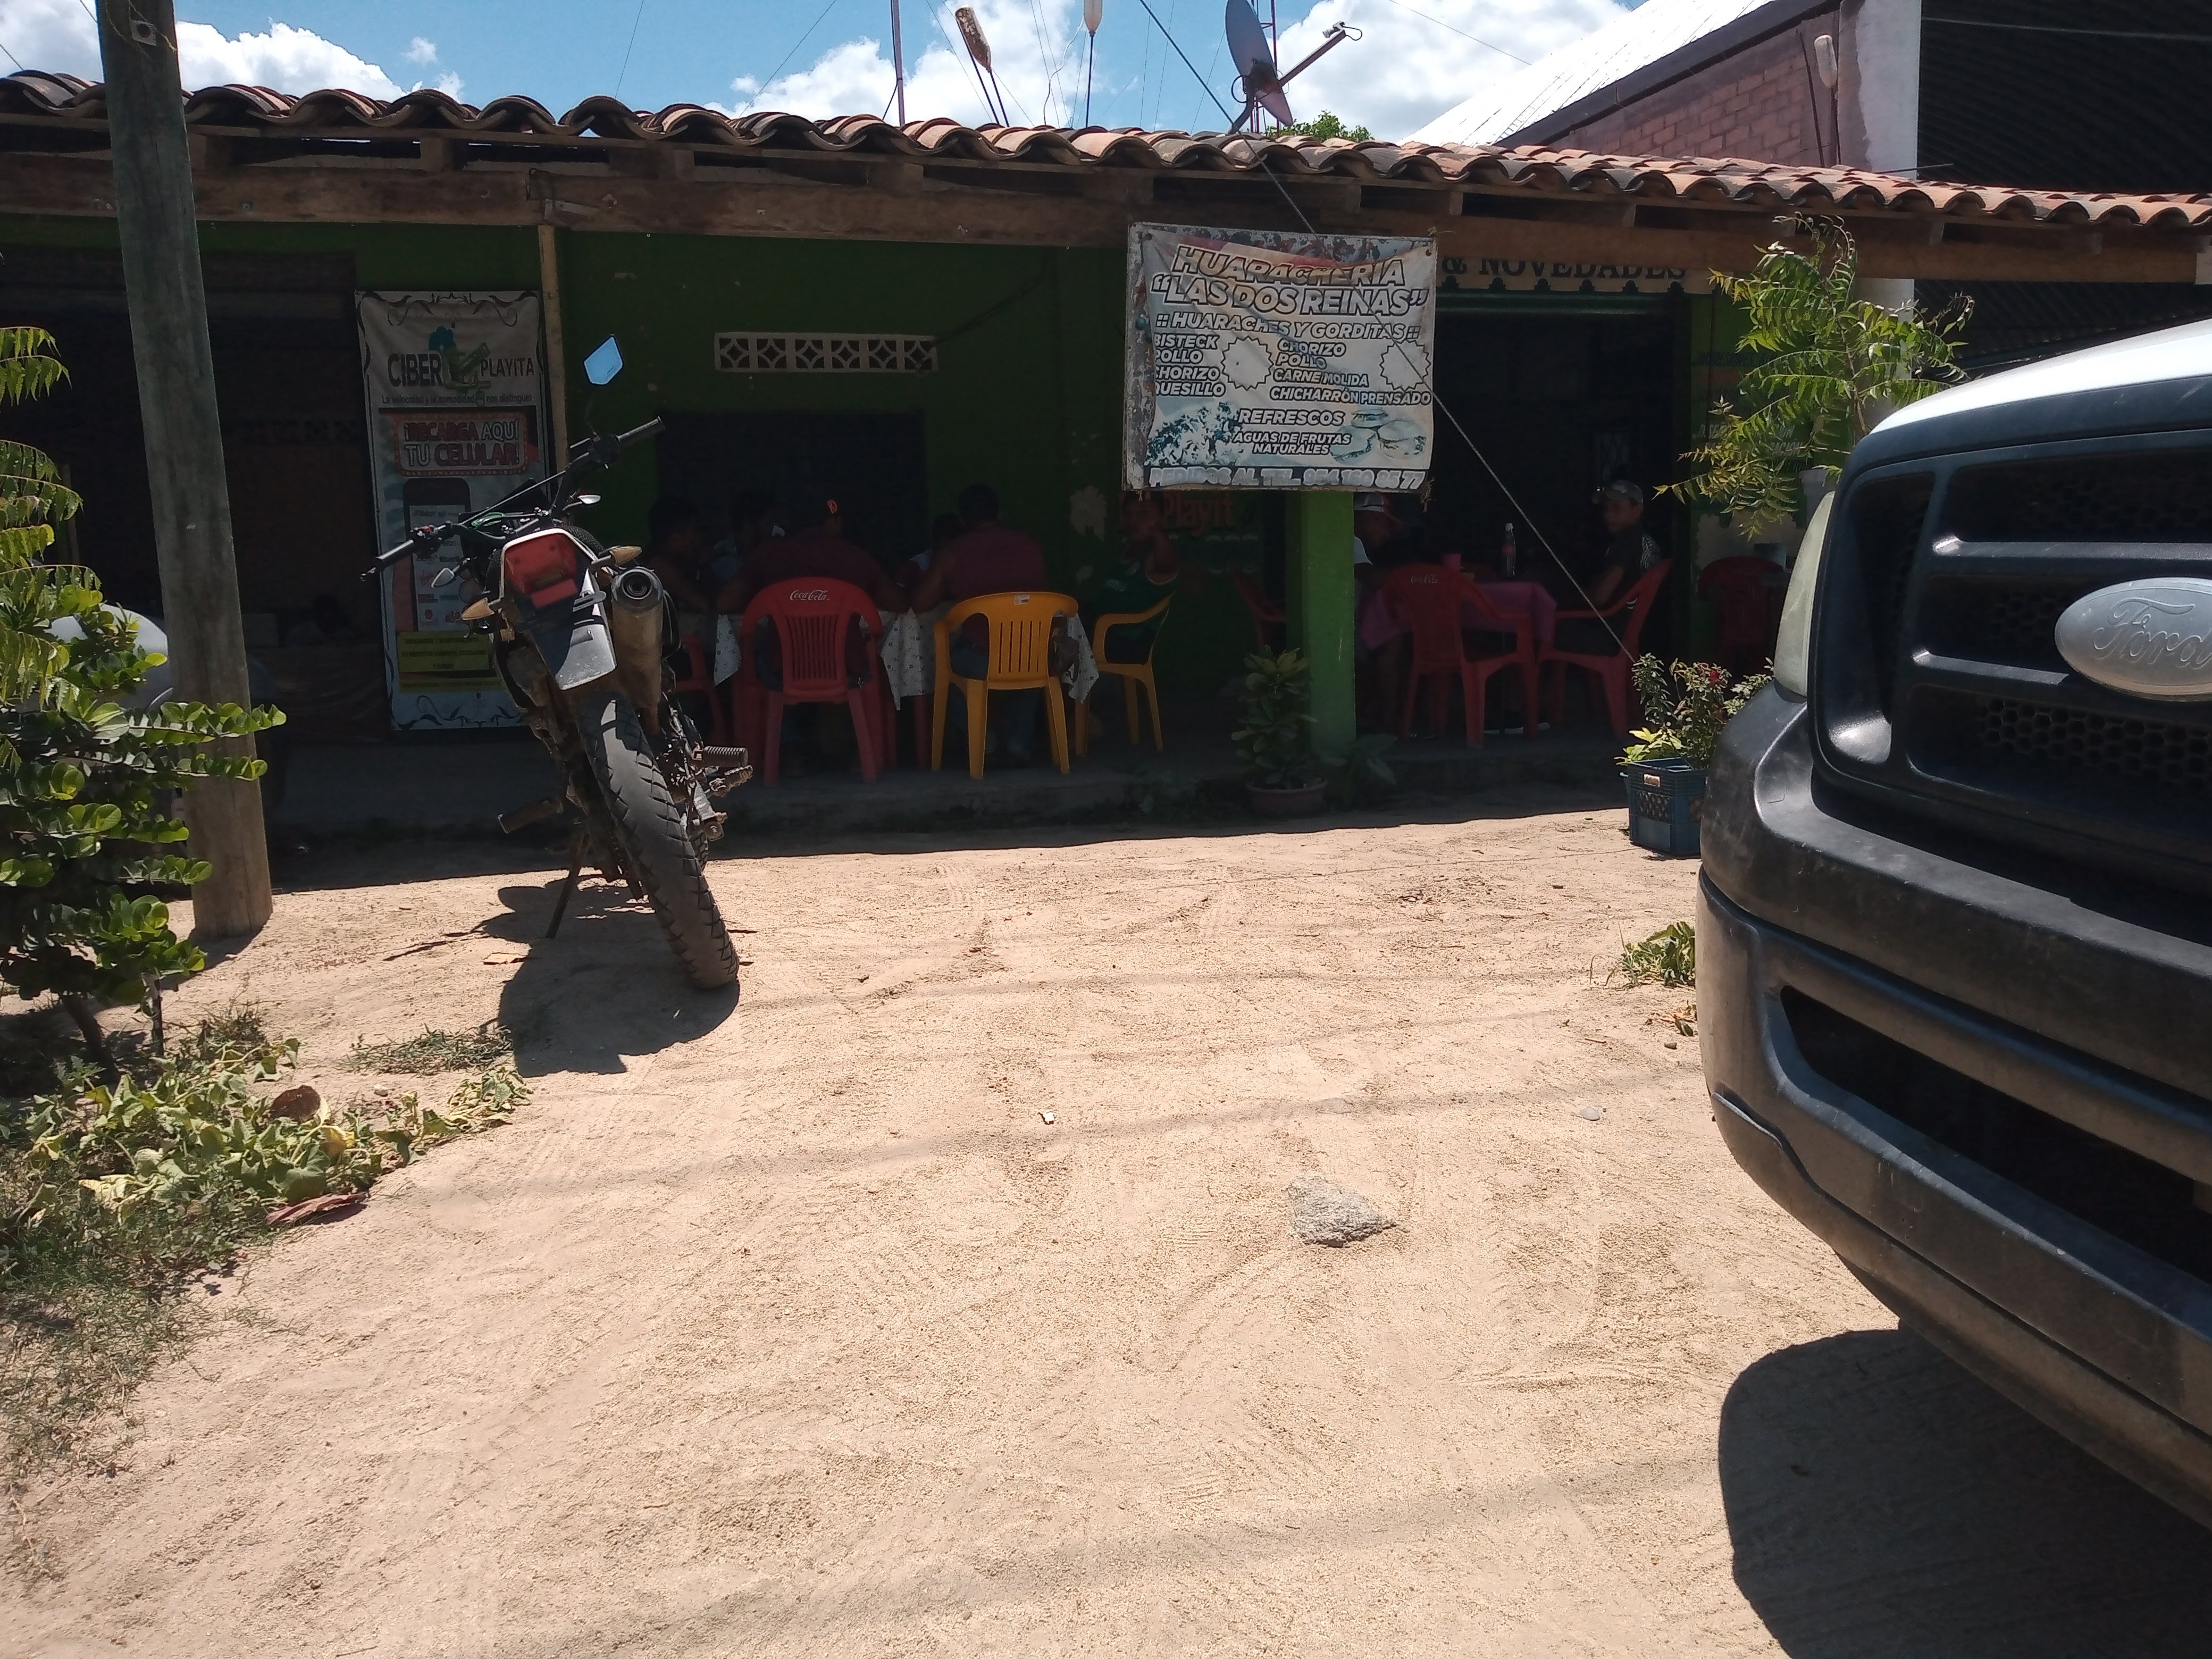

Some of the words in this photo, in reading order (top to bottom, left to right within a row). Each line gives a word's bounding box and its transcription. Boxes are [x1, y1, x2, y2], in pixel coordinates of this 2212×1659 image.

[1479, 258, 1686, 280] NOVEDADES
[1231, 284, 1299, 314] DOS
[1170, 312, 1292, 336] HUARACHES
[1294, 322, 1312, 338] Y
[1310, 322, 1406, 340] GORDITAS
[1153, 333, 1220, 349] BISTECK
[1278, 338, 1346, 357] CHORIZO
[388, 353, 444, 387] CIBER
[481, 357, 535, 377] PLAYITA
[1275, 353, 1327, 370] POLLO
[1273, 368, 1322, 384] CARNE
[1321, 372, 1369, 388] MOLIDA
[1270, 386, 1359, 404] CHICHARRÓN
[1360, 391, 1431, 405] PRENSADO
[1238, 408, 1346, 425] REFRESCOS
[481, 418, 520, 442] AQUÍ
[1232, 431, 1279, 443] AGUAS
[1279, 432, 1301, 443] DE
[1301, 432, 1352, 445] FRUTAS
[404, 443, 430, 466] TU
[433, 442, 520, 466] CELULAR!
[1252, 443, 1331, 455] NATURALES
[1149, 466, 1232, 488] PEDIDOS
[1231, 467, 1259, 486] AL
[1399, 470, 1426, 490] 77
[2089, 597, 2212, 669] Ford
